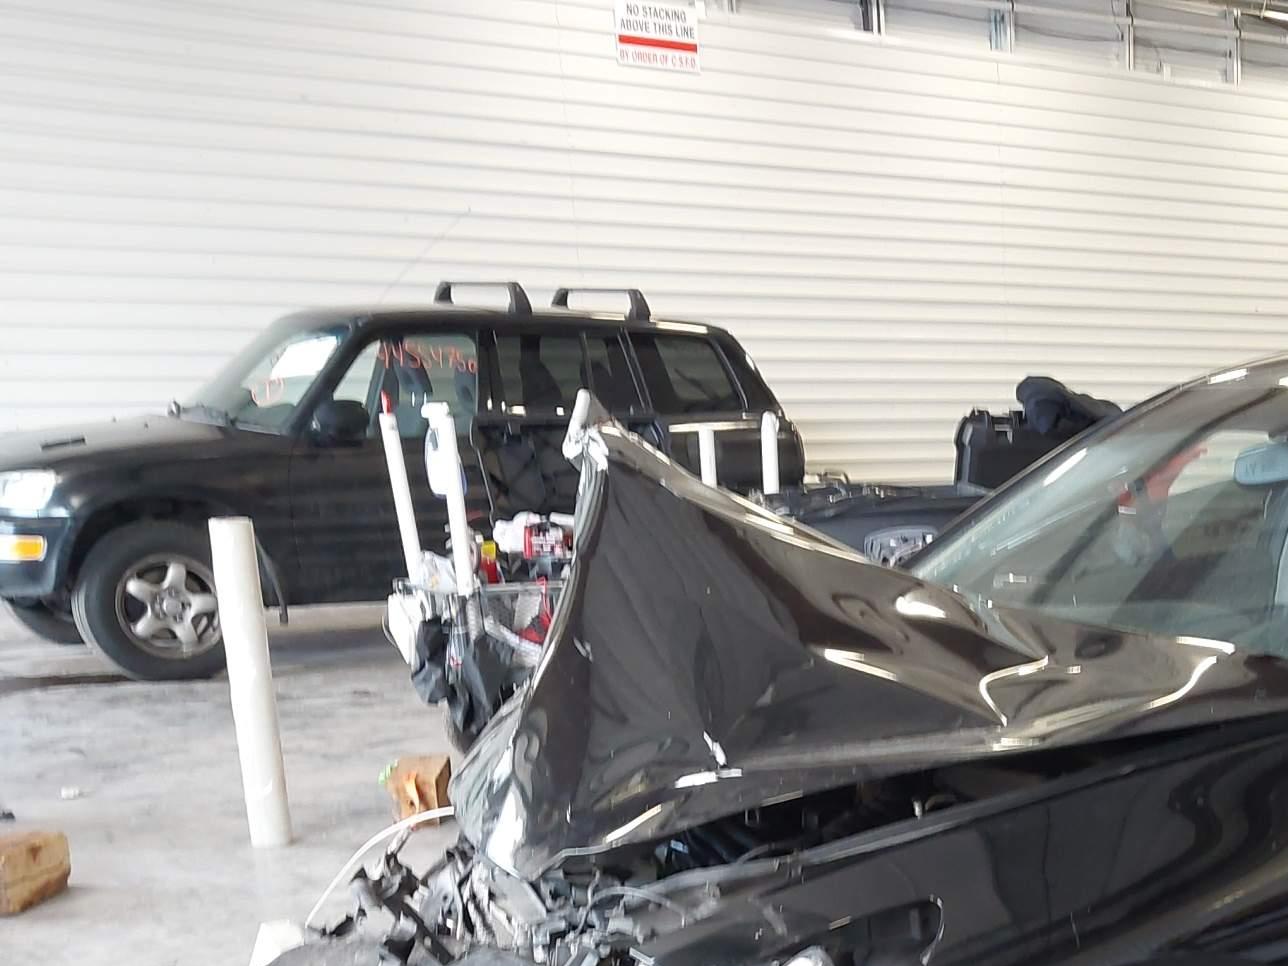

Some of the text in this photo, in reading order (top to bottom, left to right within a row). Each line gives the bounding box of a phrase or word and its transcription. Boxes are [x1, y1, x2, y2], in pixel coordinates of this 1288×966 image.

[626, 3, 687, 23] NO STACKING
[620, 18, 696, 39] ABOVE THIS LINE
